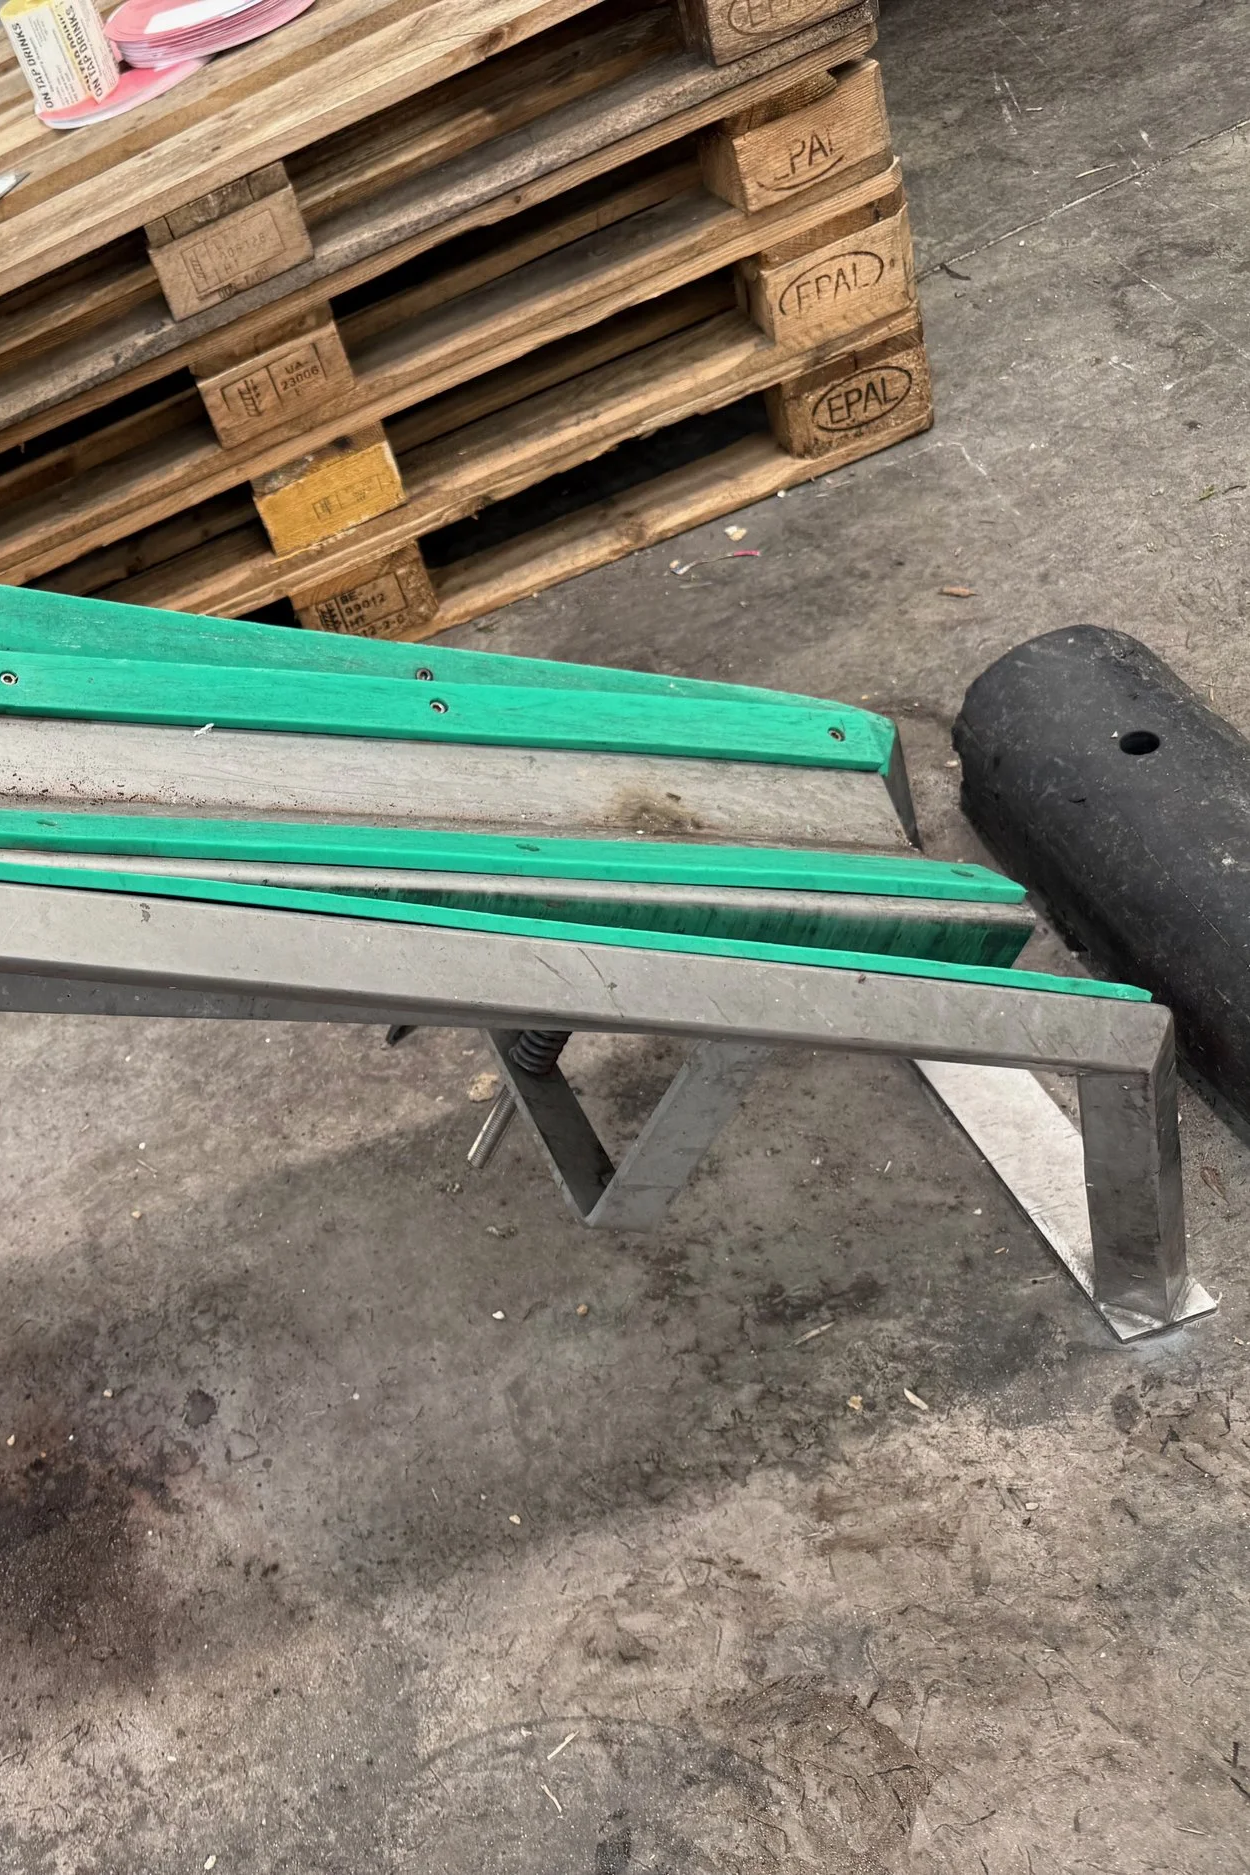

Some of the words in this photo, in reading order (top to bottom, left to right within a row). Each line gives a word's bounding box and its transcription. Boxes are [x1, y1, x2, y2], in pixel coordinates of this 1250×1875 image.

[65, 5, 88, 54] DRINKS
[11, 22, 37, 67] DRINKS
[83, 55, 97, 77] TAP
[30, 69, 47, 89] TAP
[92, 77, 103, 98] ON
[41, 91, 54, 109] ON
[280, 365, 319, 391] 23006
[827, 377, 899, 425] EPAL
